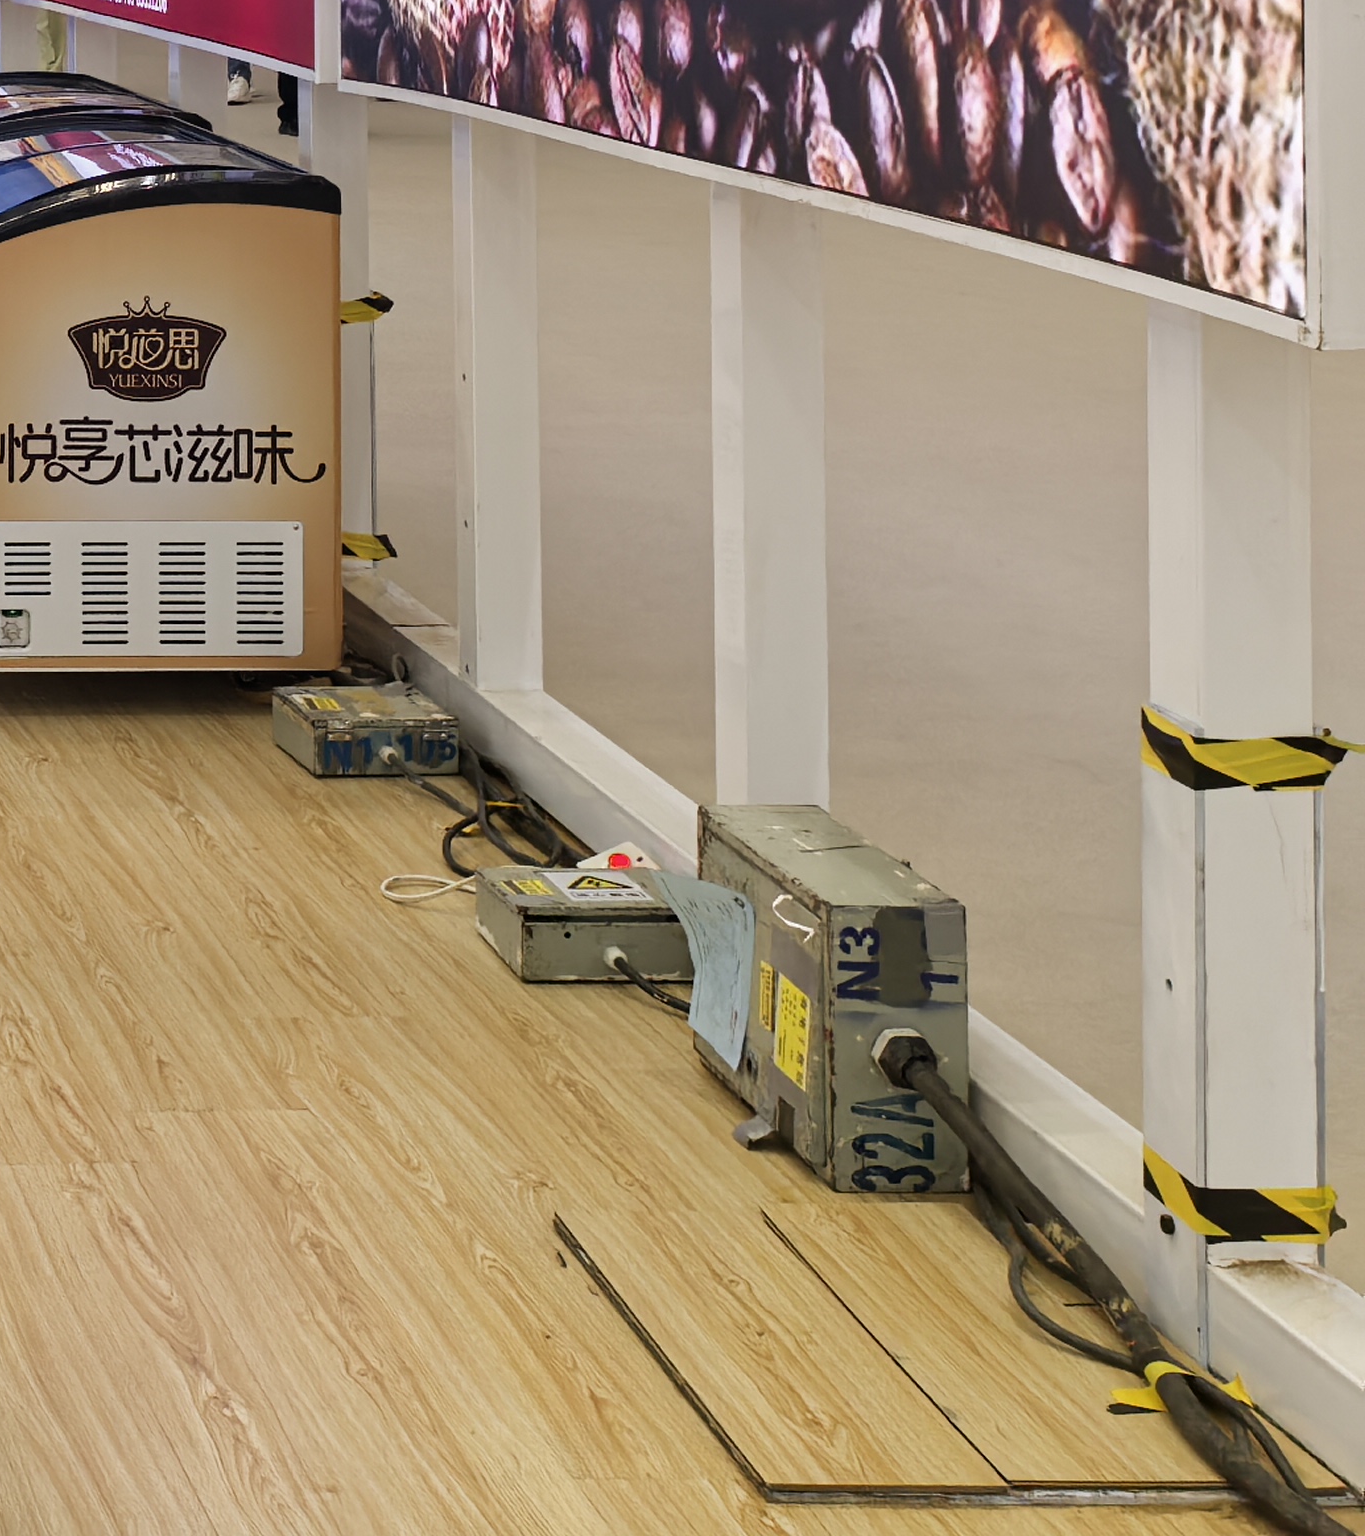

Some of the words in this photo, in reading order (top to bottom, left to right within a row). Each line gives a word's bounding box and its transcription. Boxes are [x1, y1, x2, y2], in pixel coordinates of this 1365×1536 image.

[109, 372, 183, 389] YUEXINSI
[0, 416, 327, 486] 悦享芯滋味
[836, 926, 881, 1001] N3
